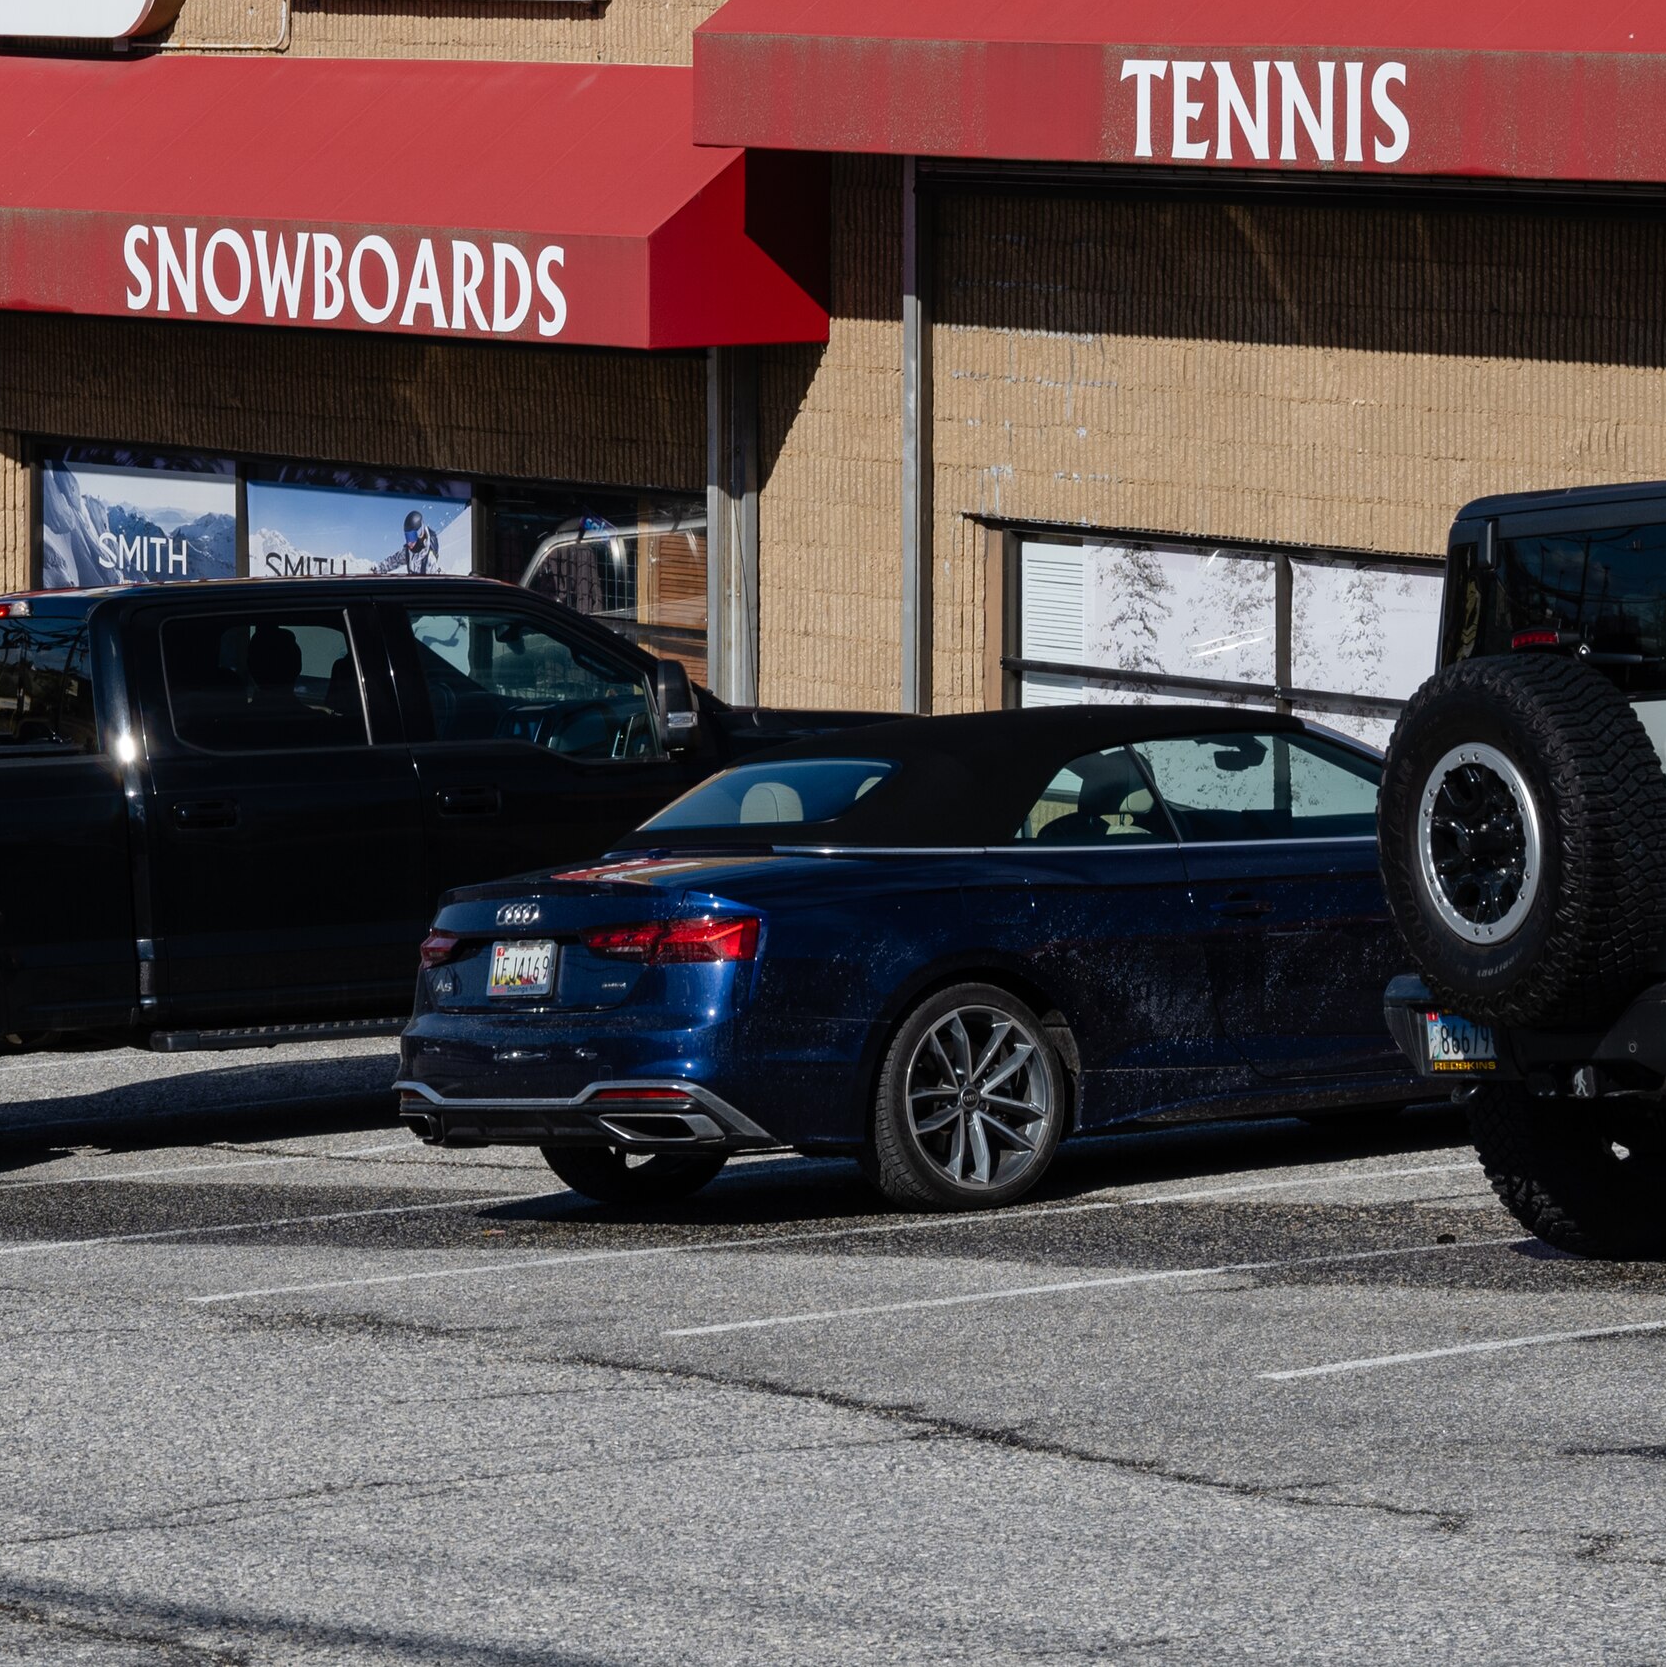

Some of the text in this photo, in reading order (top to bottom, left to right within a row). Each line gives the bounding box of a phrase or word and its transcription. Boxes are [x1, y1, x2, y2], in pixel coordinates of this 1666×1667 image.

[1121, 60, 1411, 164] TENNIS
[124, 224, 568, 337] SNOWBOARDS
[98, 531, 188, 576] SMITH
[435, 979, 453, 993] A5
[493, 954, 550, 984] 1FJ4169
[1433, 1061, 1497, 1071] REDSKINS
